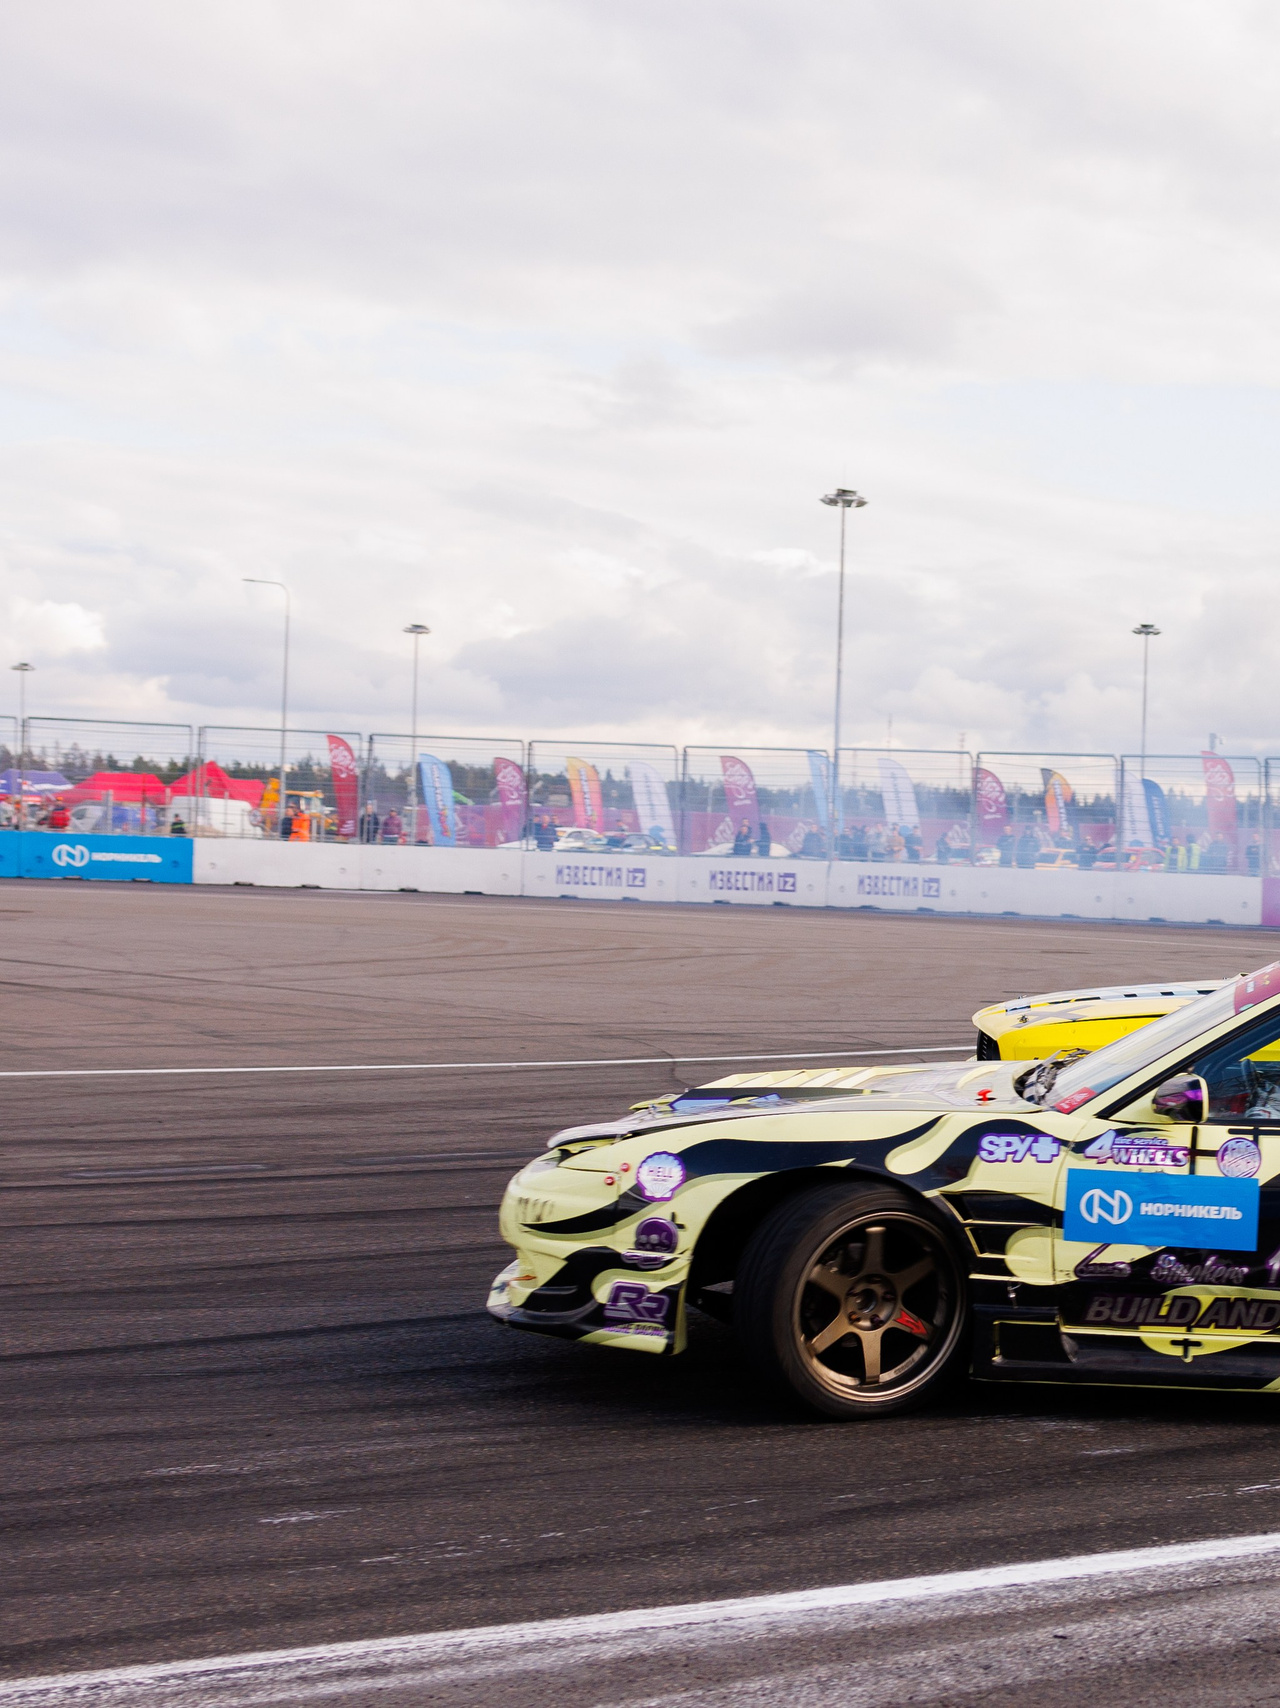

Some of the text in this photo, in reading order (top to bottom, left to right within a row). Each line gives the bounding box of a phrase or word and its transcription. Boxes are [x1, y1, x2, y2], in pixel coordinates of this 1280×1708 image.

[556, 865, 622, 886] ИЗВЕСТИЯ
[709, 870, 773, 892] ИЗВЕСТИЯ
[857, 875, 919, 897] ИЗВЕСТИЯ
[1084, 1130, 1117, 1164] 4
[1111, 1148, 1189, 1166] WHEELS
[1133, 1136, 1168, 1146] service
[1140, 1202, 1242, 1220] НОРНИКЕЛЬ
[1085, 1297, 1199, 1326] BUILD
